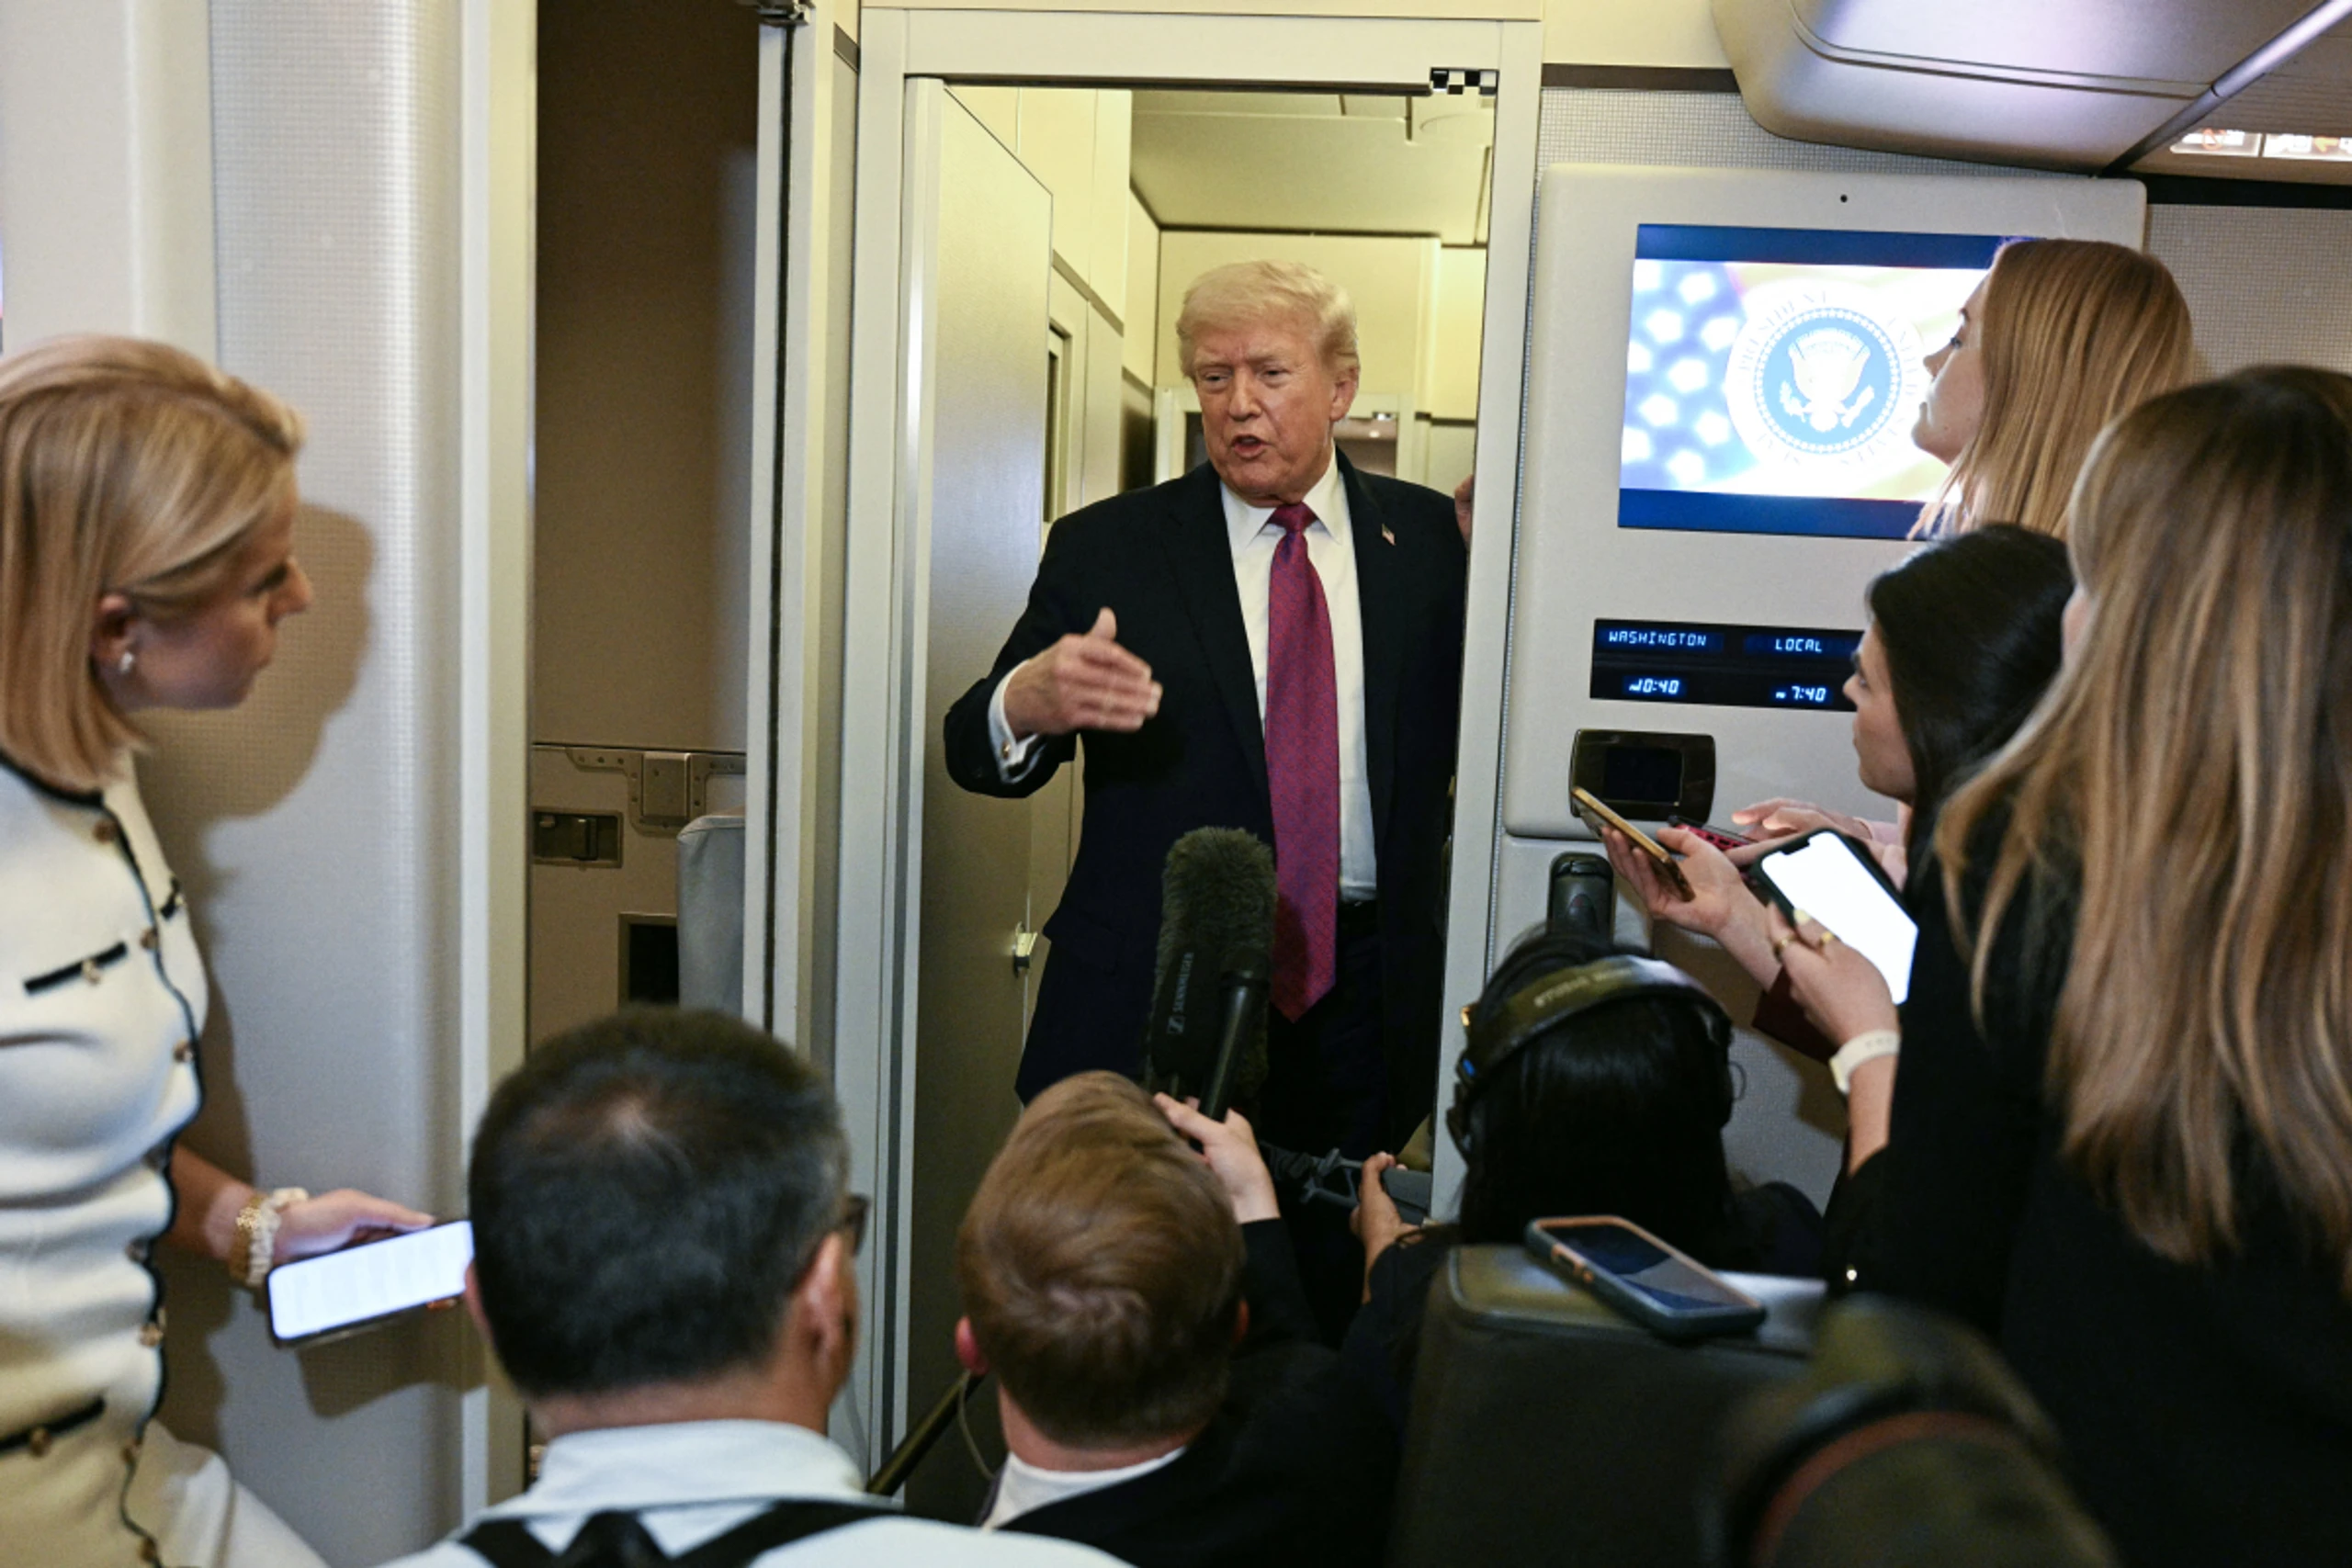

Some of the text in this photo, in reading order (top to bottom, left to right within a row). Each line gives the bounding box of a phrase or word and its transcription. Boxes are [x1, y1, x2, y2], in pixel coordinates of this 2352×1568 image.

[1609, 630, 1707, 647] WASHINGTON
[1775, 638, 1823, 653] LOCAL
[1636, 677, 1679, 694] 10:40
[1791, 685, 1826, 703] 7:40
